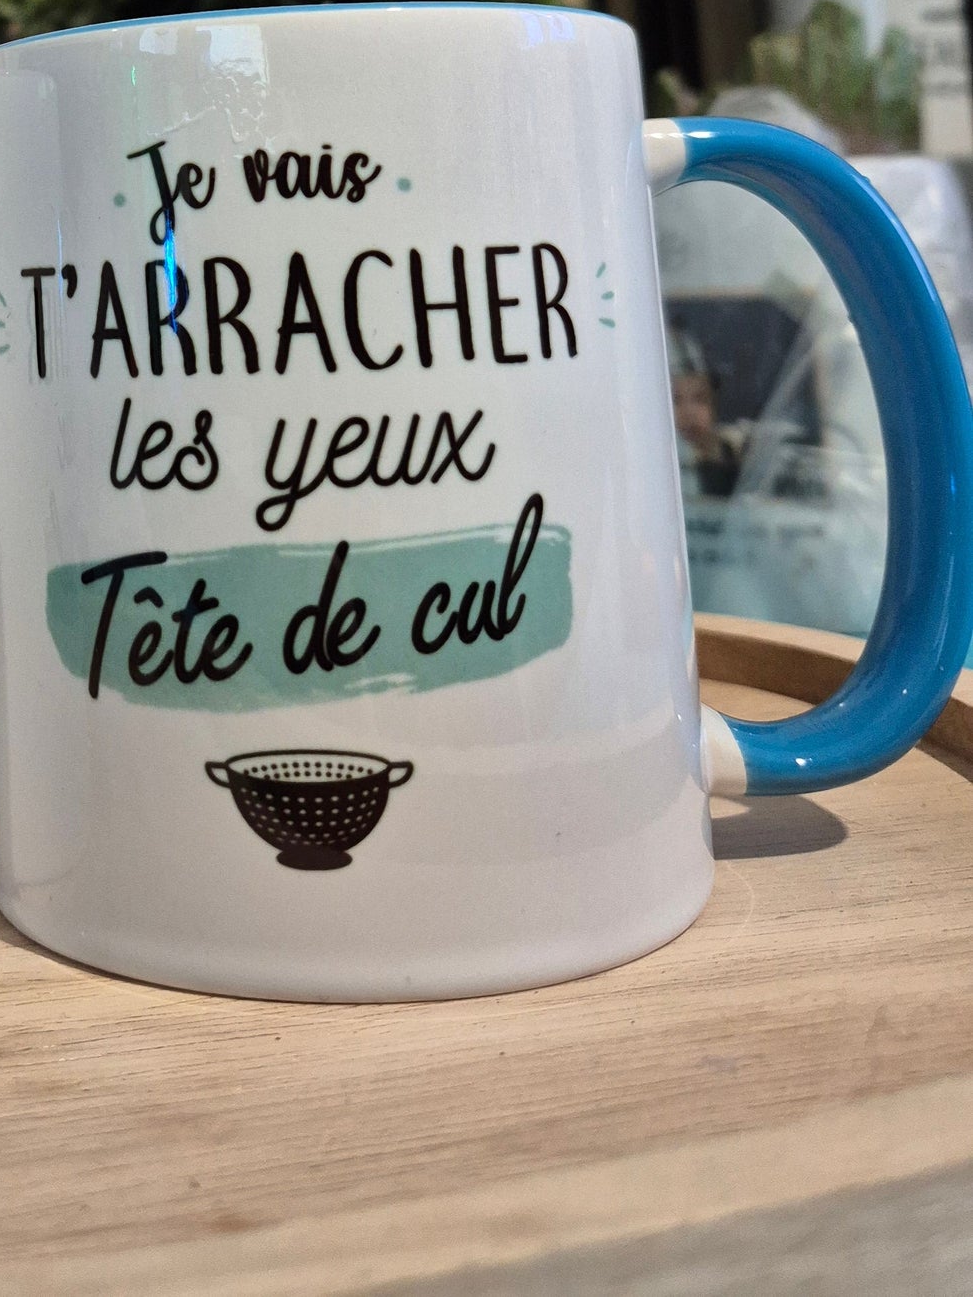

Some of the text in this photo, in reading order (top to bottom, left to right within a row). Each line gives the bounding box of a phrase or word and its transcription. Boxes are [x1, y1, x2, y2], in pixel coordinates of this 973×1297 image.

[127, 141, 382, 246] Je vais
[21, 243, 577, 379] T’ARRACHER
[109, 397, 497, 532] les yeux
[80, 550, 254, 700] Tête
[282, 540, 382, 676] de
[411, 493, 545, 655] cul
